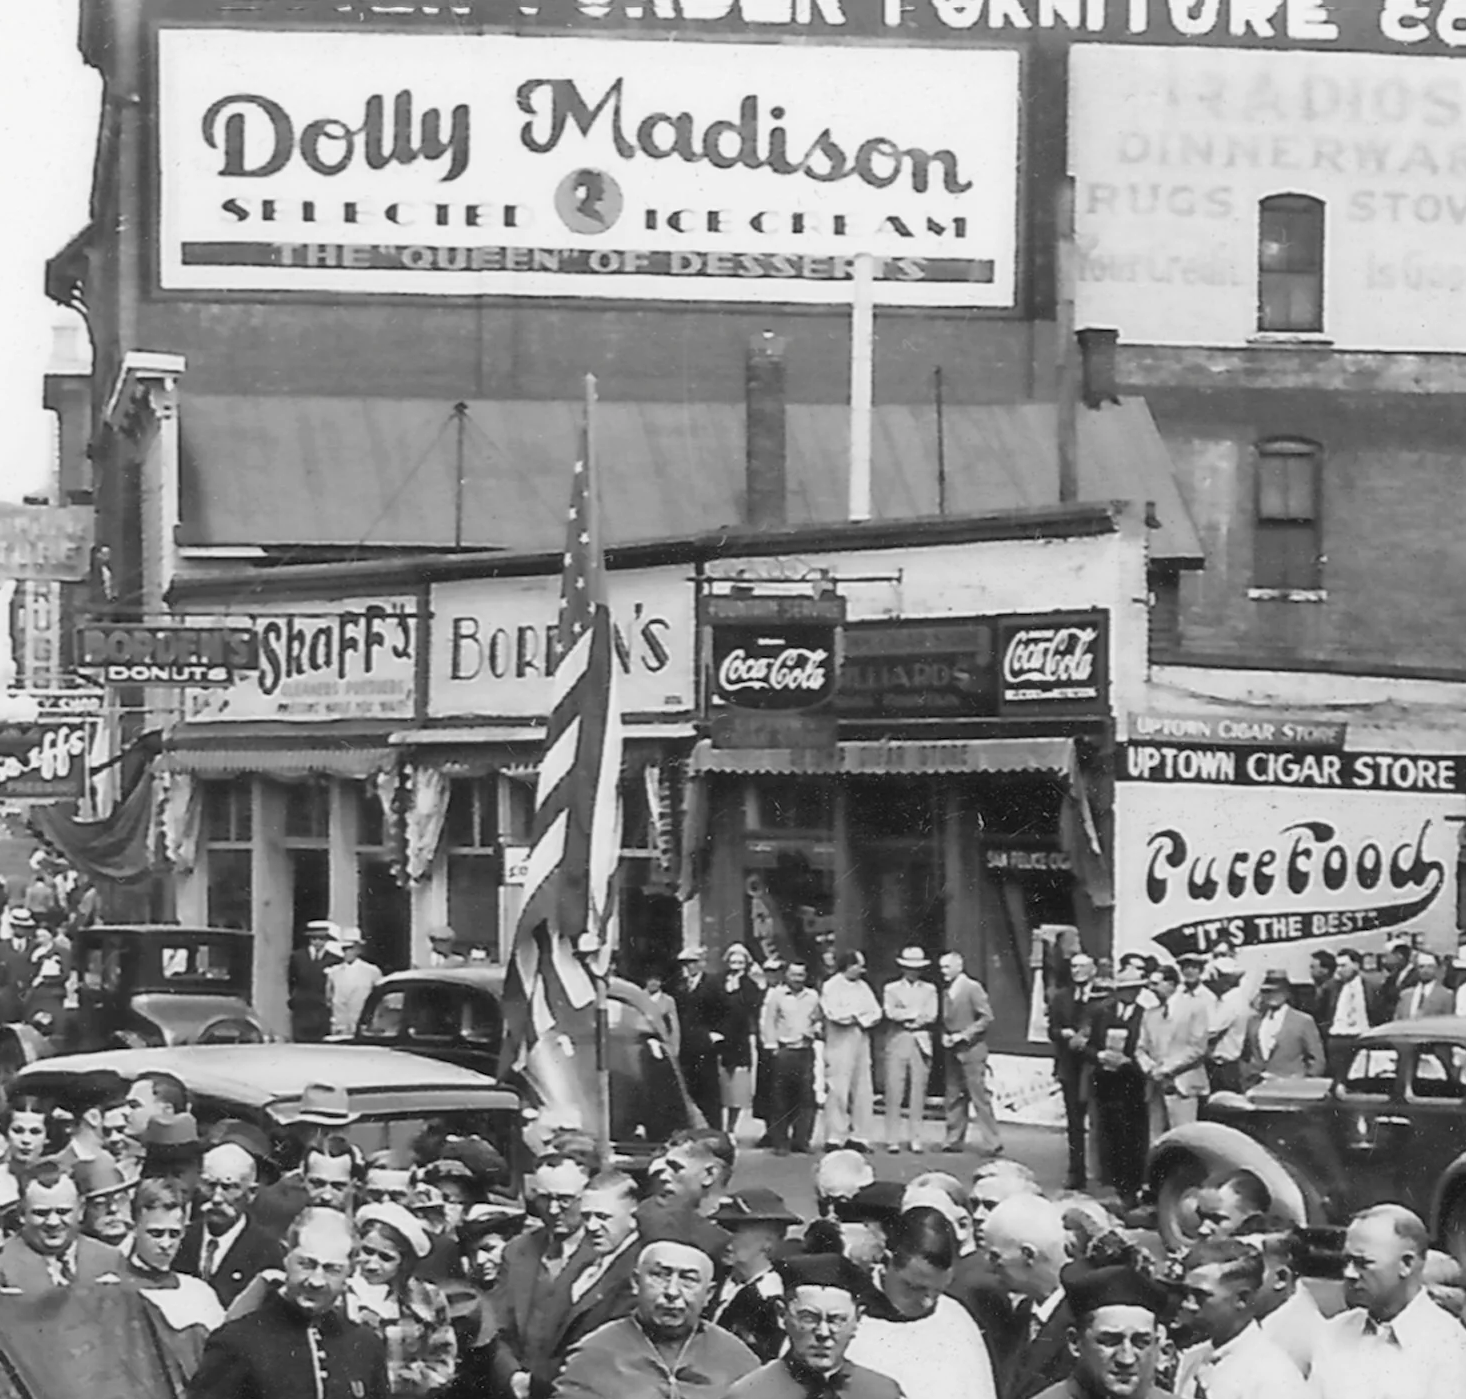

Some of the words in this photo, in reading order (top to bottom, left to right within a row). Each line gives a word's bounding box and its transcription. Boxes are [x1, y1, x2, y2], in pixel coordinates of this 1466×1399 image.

[202, 90, 470, 182] Dolly
[517, 77, 972, 194] Madison
[221, 198, 531, 228] SELECTED
[1086, 181, 1235, 219] RUGS
[271, 243, 372, 267] THE
[381, 245, 580, 272] "QUEEN"
[588, 251, 650, 273] OF
[670, 252, 928, 280] DESSERTS
[450, 603, 671, 680] BORN'S
[108, 666, 228, 681] DONUTS
[1136, 716, 1211, 737] UPTOWN
[1218, 719, 1274, 741] CIGAR
[1281, 723, 1339, 743] STORE
[1127, 746, 1235, 781] UPTOWN
[1246, 752, 1341, 785] CIGAR
[1352, 757, 1456, 790] STORE
[1183, 917, 1245, 950] "IT'S
[1254, 916, 1302, 940] THE
[1312, 910, 1379, 935] BEST"
